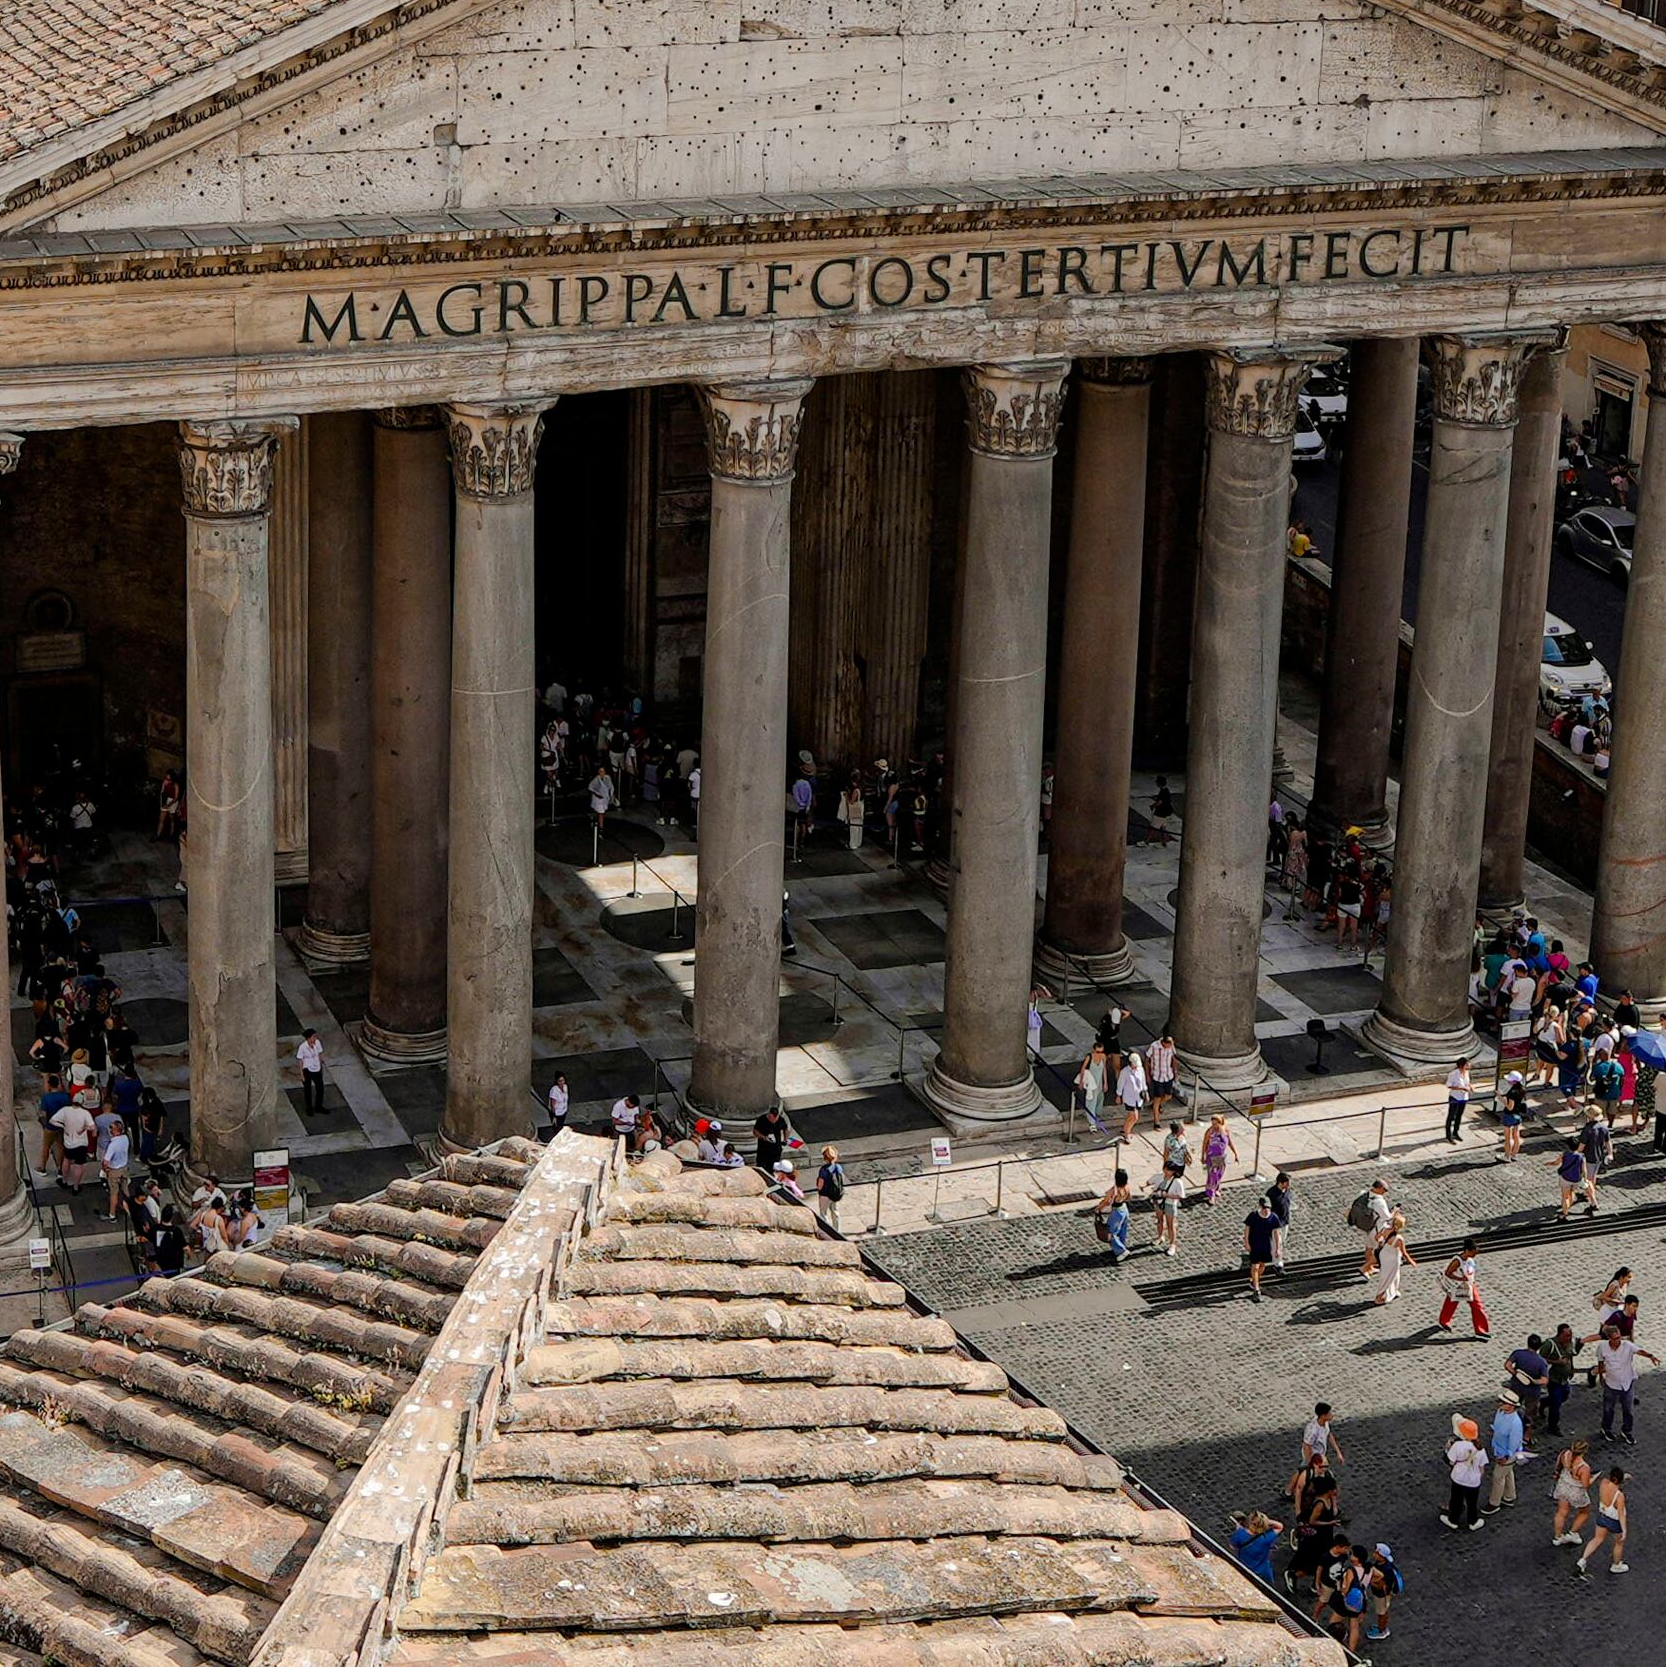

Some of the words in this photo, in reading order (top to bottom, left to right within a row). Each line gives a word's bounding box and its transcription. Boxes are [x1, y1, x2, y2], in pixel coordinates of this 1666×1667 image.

[298, 290, 367, 343] M
[374, 270, 701, 340] AGRIPPA
[714, 266, 747, 318] L
[761, 263, 794, 314] F
[810, 253, 953, 310] COS
[965, 236, 1270, 300] TERTIVM
[1285, 225, 1470, 282] FECIT
